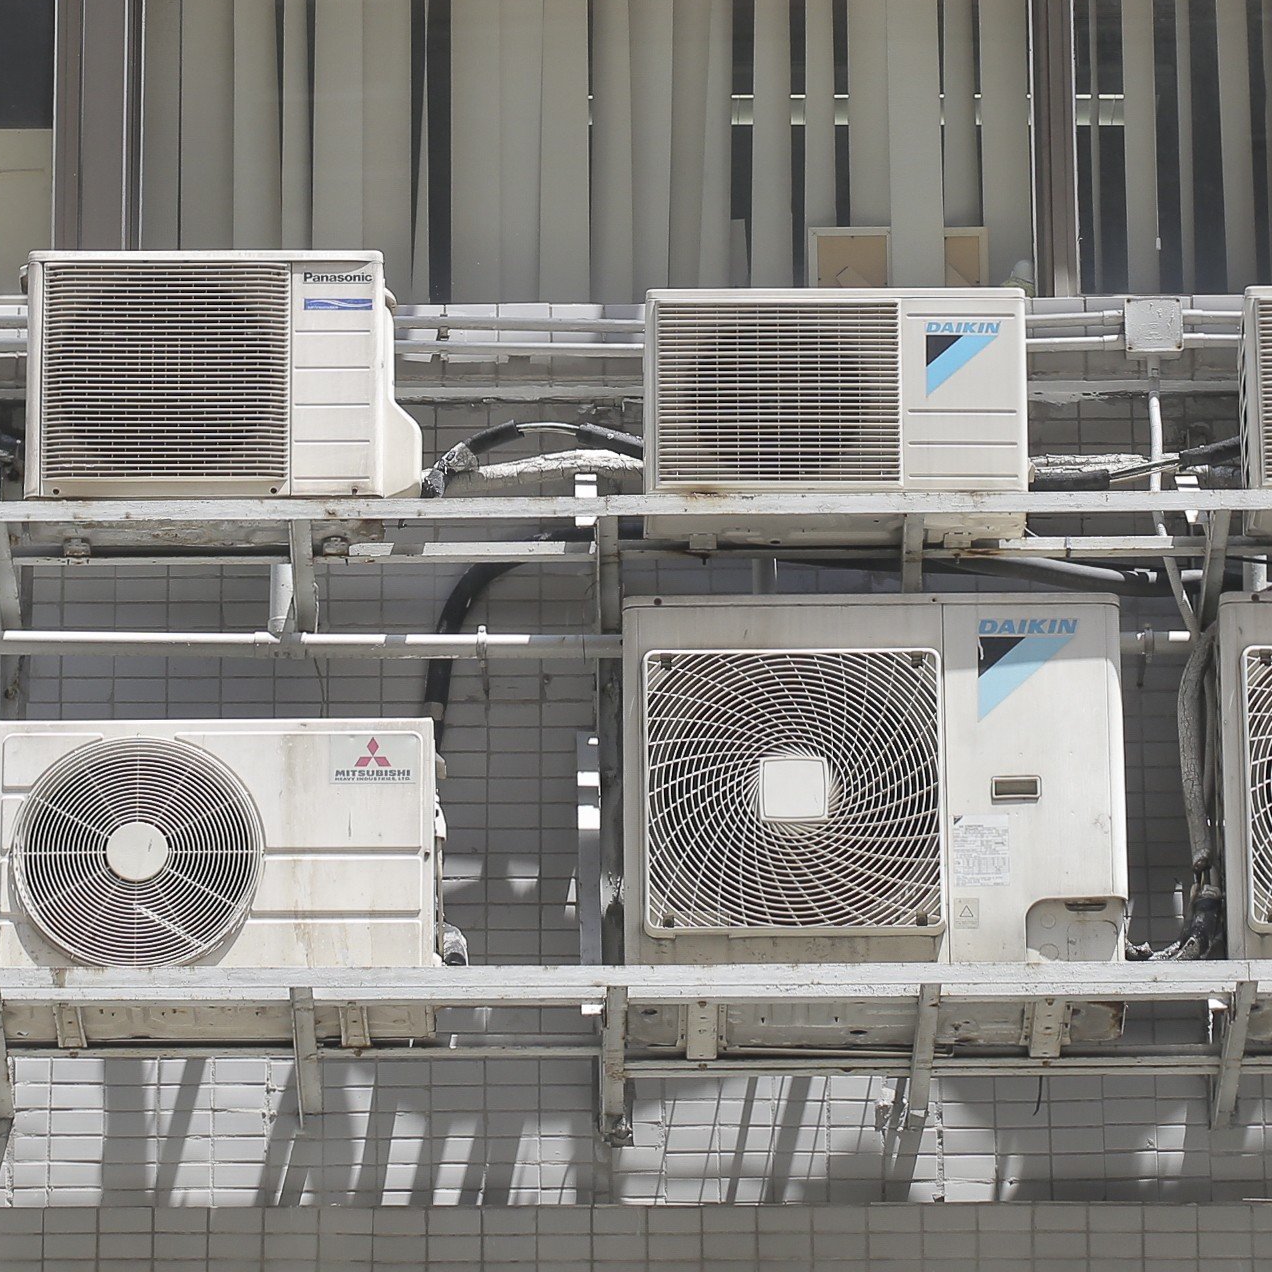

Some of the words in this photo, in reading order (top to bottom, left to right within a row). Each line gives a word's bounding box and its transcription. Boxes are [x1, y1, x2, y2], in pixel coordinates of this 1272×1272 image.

[303, 272, 373, 282] Panasonic
[926, 321, 1000, 333] DAIKIN
[978, 619, 1078, 634] DAIKIN
[335, 769, 411, 777] MITSUBISHI
